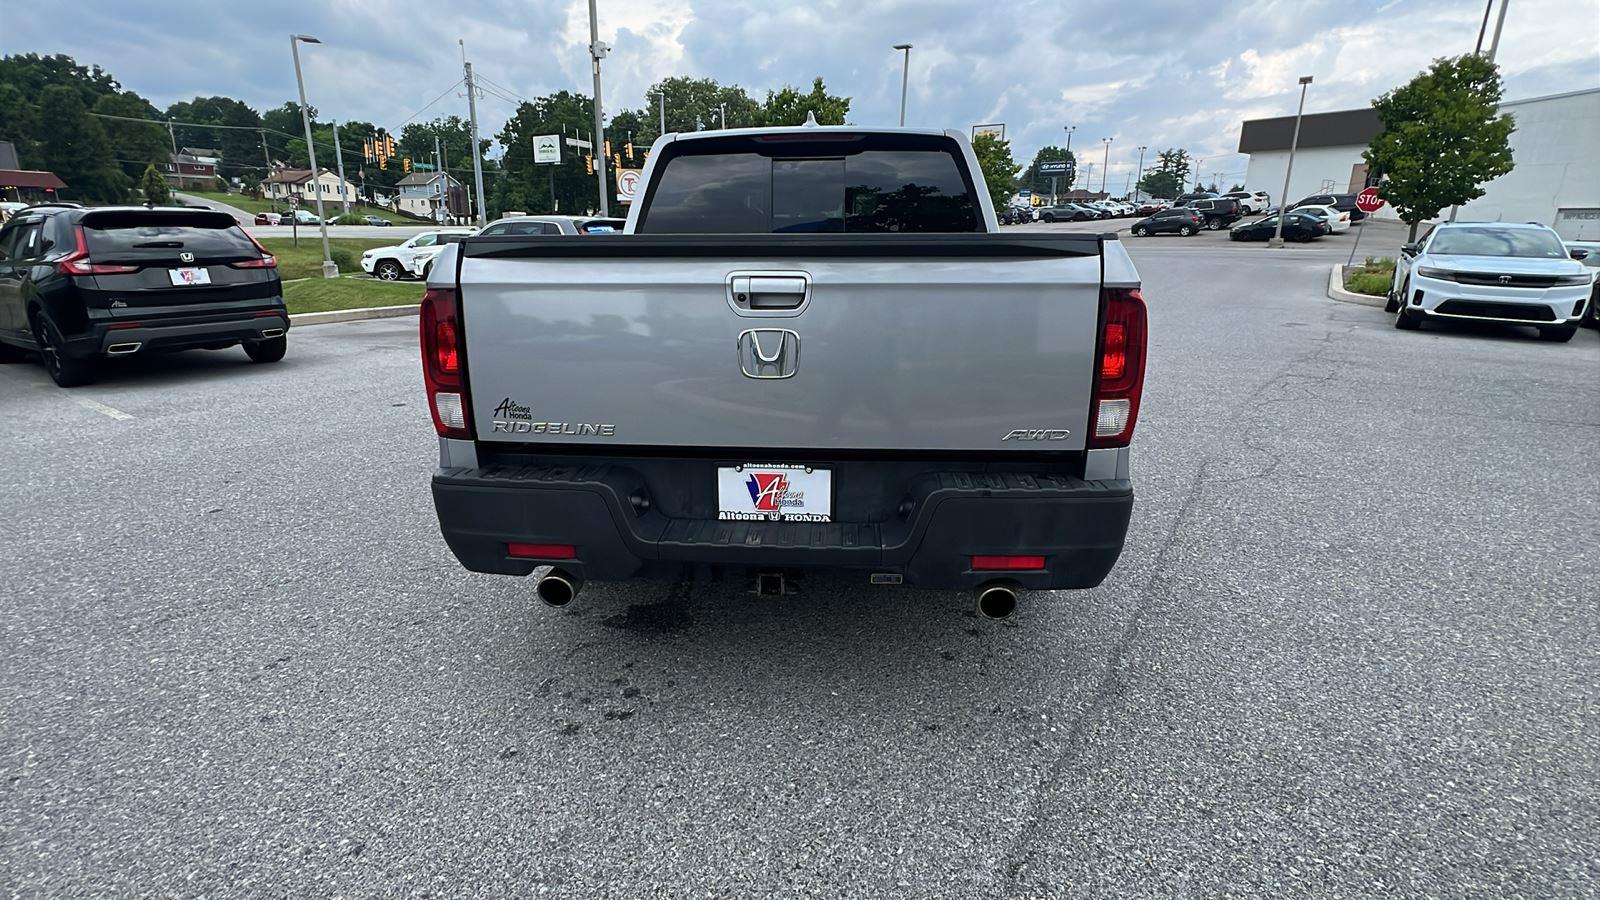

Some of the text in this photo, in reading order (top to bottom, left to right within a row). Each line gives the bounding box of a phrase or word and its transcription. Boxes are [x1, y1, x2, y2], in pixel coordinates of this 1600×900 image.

[493, 397, 531, 419] Altoona
[509, 411, 533, 420] Honda
[491, 420, 616, 436] RIDGELINE
[1001, 428, 1071, 441] AWD
[775, 498, 805, 508] Honda
[718, 510, 832, 523] Altoona HONDA
